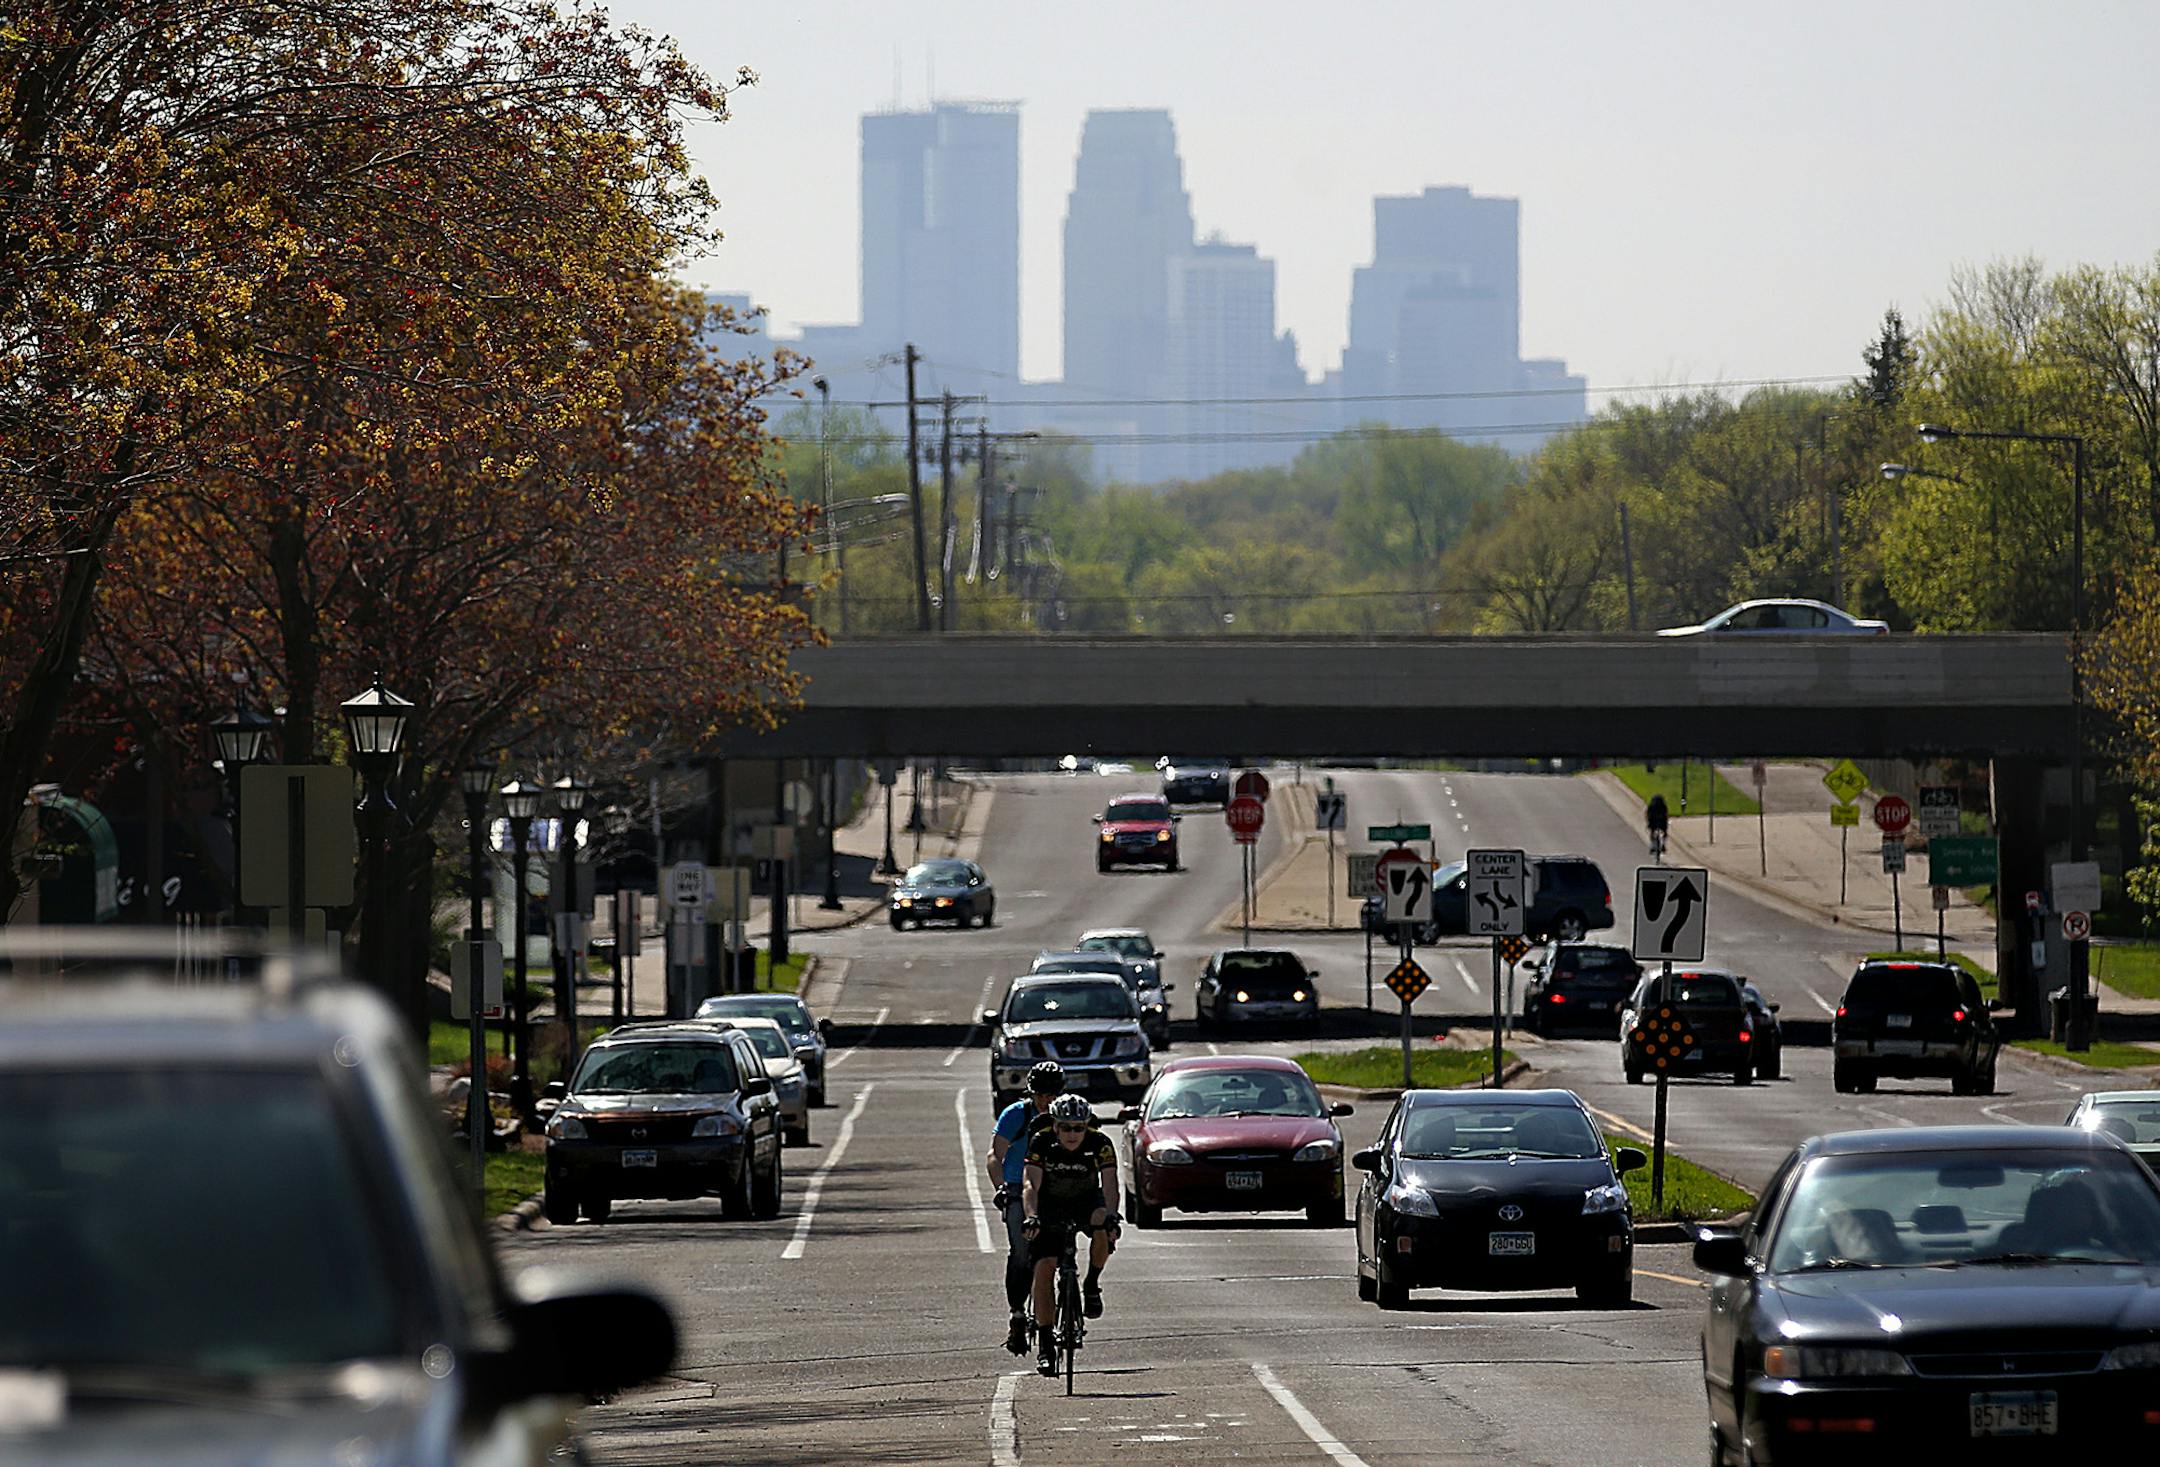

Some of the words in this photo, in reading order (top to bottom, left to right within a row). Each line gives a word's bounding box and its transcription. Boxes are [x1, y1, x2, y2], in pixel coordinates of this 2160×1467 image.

[1228, 806, 1262, 824] STOP
[1876, 806, 1909, 823] STOP
[1475, 854, 1516, 864] CENTER
[1481, 866, 1510, 875] LANE
[1480, 921, 1510, 932] ONLY
